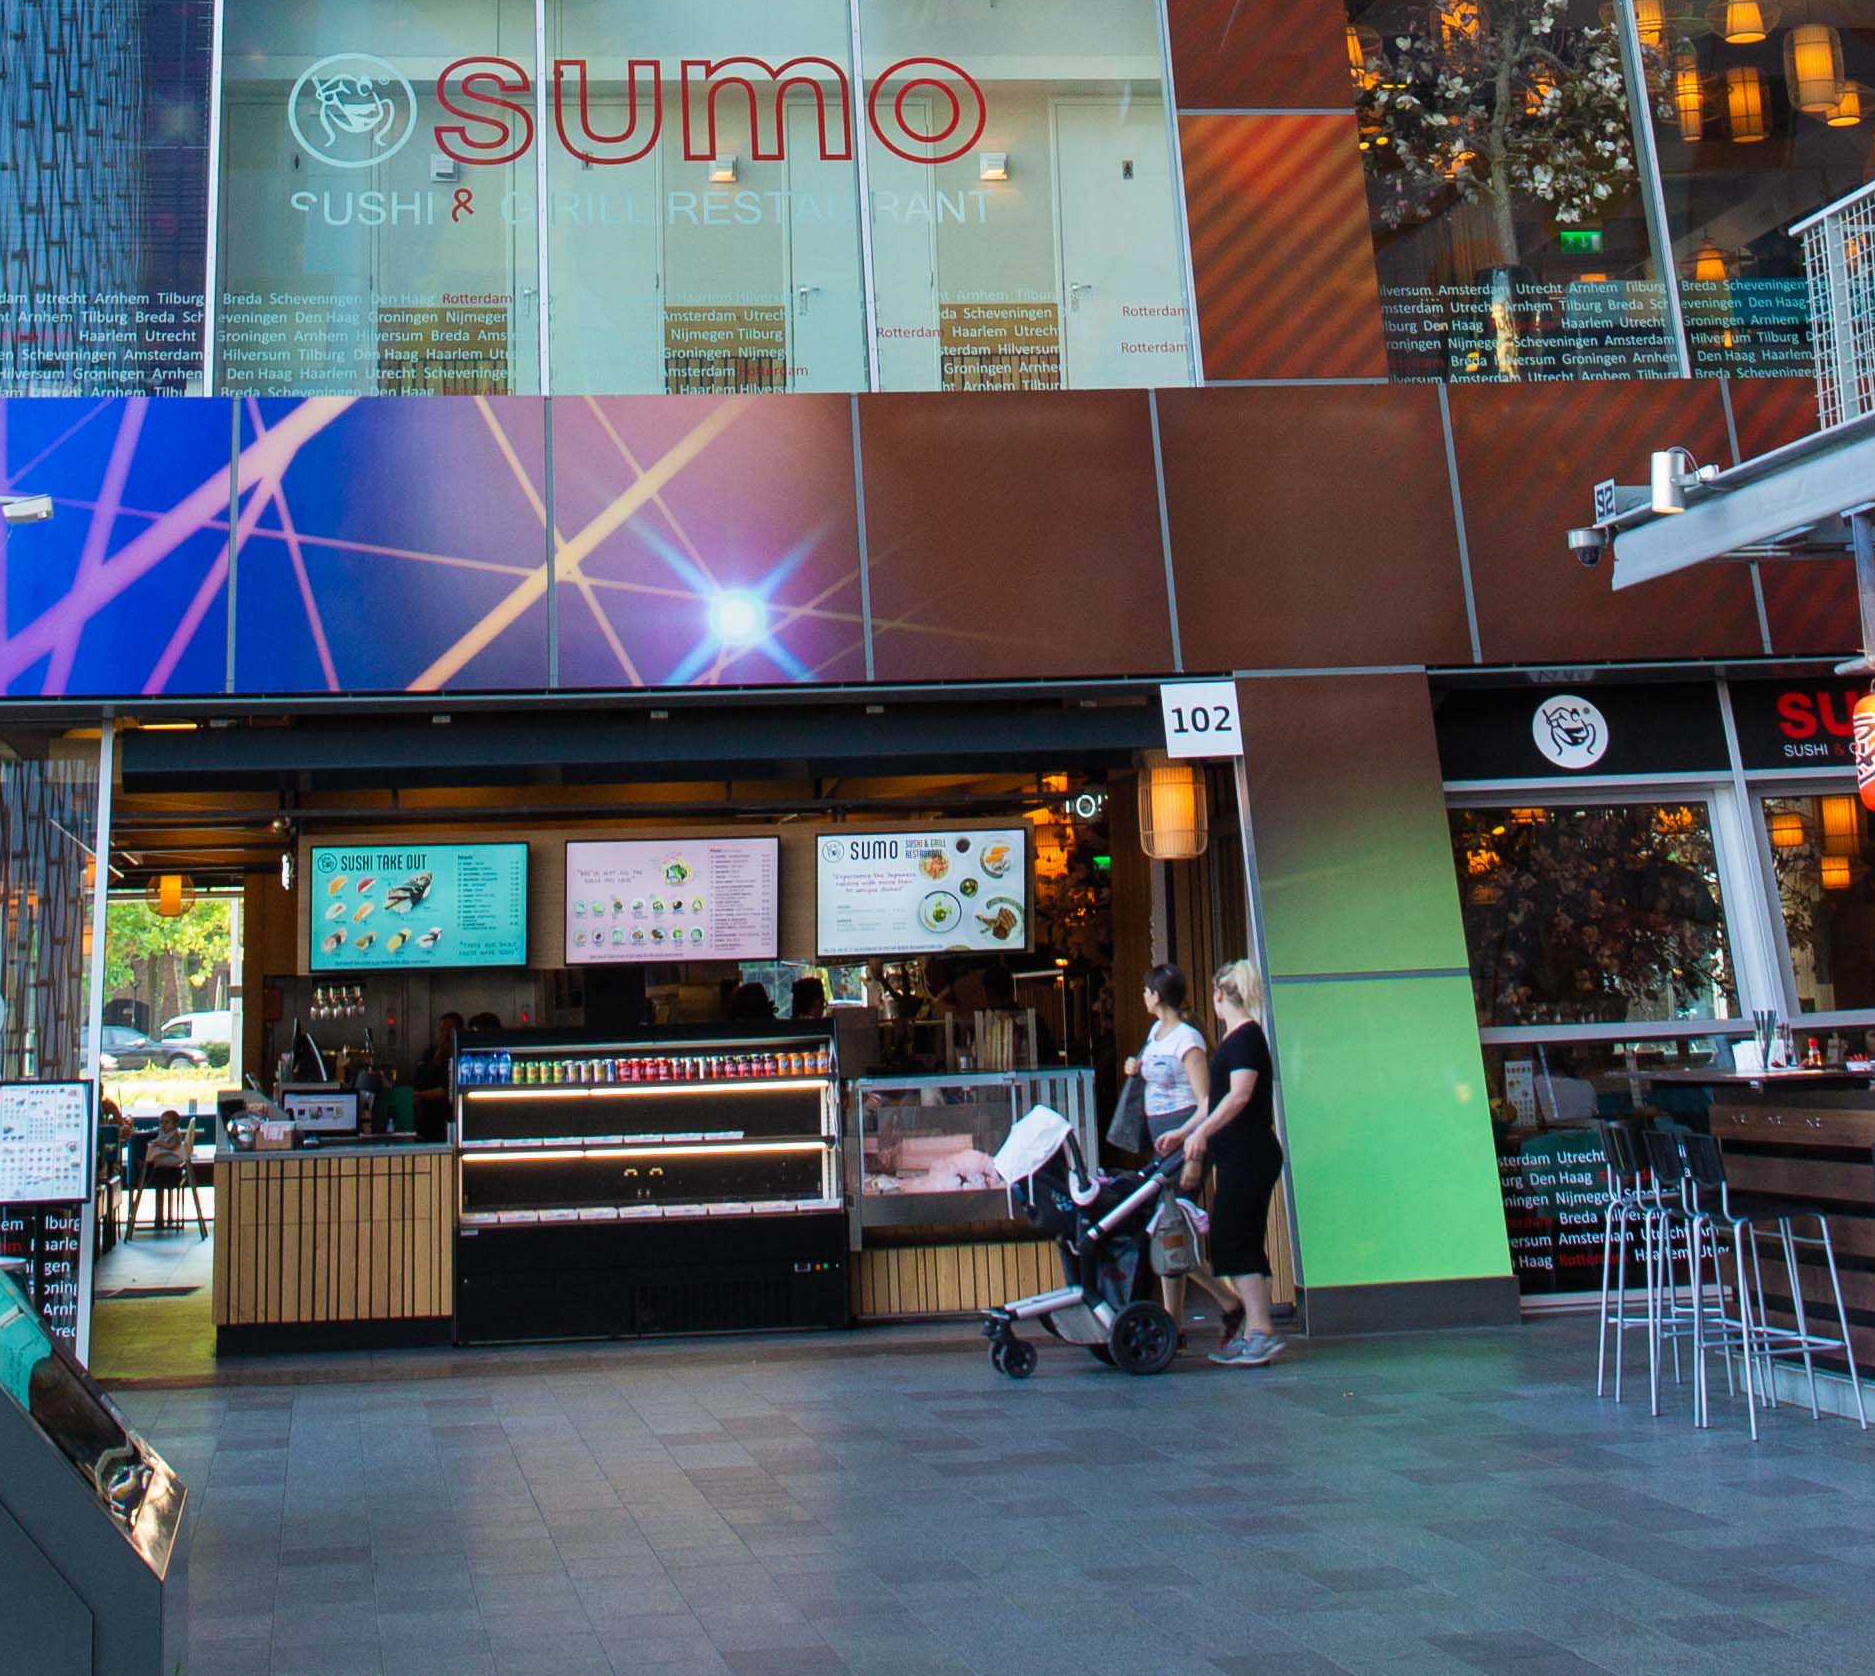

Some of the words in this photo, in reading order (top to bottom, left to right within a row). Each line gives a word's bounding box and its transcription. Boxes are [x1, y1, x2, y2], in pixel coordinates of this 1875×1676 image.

[433, 56, 987, 166] sumo
[1438, 283, 1510, 296] Amsterdam
[1516, 282, 1563, 294] Utrecht
[1569, 281, 1618, 293] Arnhem
[1681, 280, 1717, 292] Breda
[1722, 279, 1806, 292] Scheveningen
[35, 291, 87, 304] Utrecht
[94, 291, 150, 304] Arnhem
[157, 291, 205, 308] Tilburg
[223, 292, 262, 305] Breda
[269, 291, 362, 308] Scheveningen
[441, 291, 514, 305] Rotterdam
[1559, 299, 1602, 314] Tilburg
[1608, 299, 1644, 311] Breda
[1748, 296, 1773, 308] Den
[1775, 296, 1807, 310] Haag
[18, 310, 73, 323] Arnhem
[80, 310, 128, 326] Tilburg
[135, 310, 175, 323] Breda
[295, 310, 324, 323] Den
[326, 310, 360, 326] Haag
[963, 306, 1052, 322] Scheveningen
[1122, 306, 1189, 317] Rotterdam
[1750, 313, 1800, 325] Arnhem
[951, 325, 1007, 338] Haarlem
[1423, 320, 1449, 332] Den
[1451, 320, 1484, 334] Haag
[1561, 317, 1614, 330] Haarlem
[1619, 315, 1666, 328] Utrecht
[79, 328, 138, 342] Haarlem
[145, 328, 197, 342] Utrecht
[293, 329, 349, 342] Arnhem
[356, 328, 423, 342] Hilversum
[431, 328, 470, 342] Breda
[671, 327, 734, 343] Nijmegen
[736, 327, 783, 342] Tilburg
[1513, 335, 1600, 350] Scheveningen
[1604, 334, 1674, 347] Amsterdam
[1756, 331, 1800, 345] Tilburg
[1120, 341, 1189, 354] Rotterdam
[22, 348, 117, 364] Scheveningen
[123, 348, 204, 361] Amsterdam
[223, 348, 291, 362] Hilversum
[298, 348, 346, 363] Tilburg
[384, 348, 419, 364] Haag
[425, 348, 483, 361] Haarlem
[1561, 352, 1626, 366] Groningen
[1697, 350, 1723, 362] Den
[1725, 350, 1757, 364] Haag
[1761, 348, 1813, 361] Haarlem
[72, 367, 145, 383] Groningen
[227, 367, 254, 380] Den
[257, 367, 293, 382] Haag
[299, 366, 357, 380] Haarlem
[365, 366, 417, 380] Utrecht
[943, 361, 1012, 377] Groningen
[1527, 370, 1574, 382] Utrecht
[1580, 369, 1631, 381] Arnhem
[91, 385, 147, 397] Arnhem
[220, 386, 261, 397] Breda
[267, 386, 362, 397] Scheveningen
[370, 386, 398, 397] Den
[679, 382, 736, 394] Haarlem
[962, 379, 1016, 391] Arnhem
[1171, 706, 1232, 734] 102
[1783, 741, 1829, 758] SUSHI
[850, 840, 898, 861] SUMO
[905, 839, 923, 849] SUSHI
[930, 838, 946, 849] GRILL
[341, 855, 374, 872] SUSHI
[377, 854, 404, 871] TAKE
[406, 853, 428, 870] OUT
[1557, 1149, 1606, 1165] Utrecht
[1529, 1172, 1557, 1186] Den
[1559, 1170, 1593, 1187] Haag
[1559, 1211, 1598, 1225] Breda
